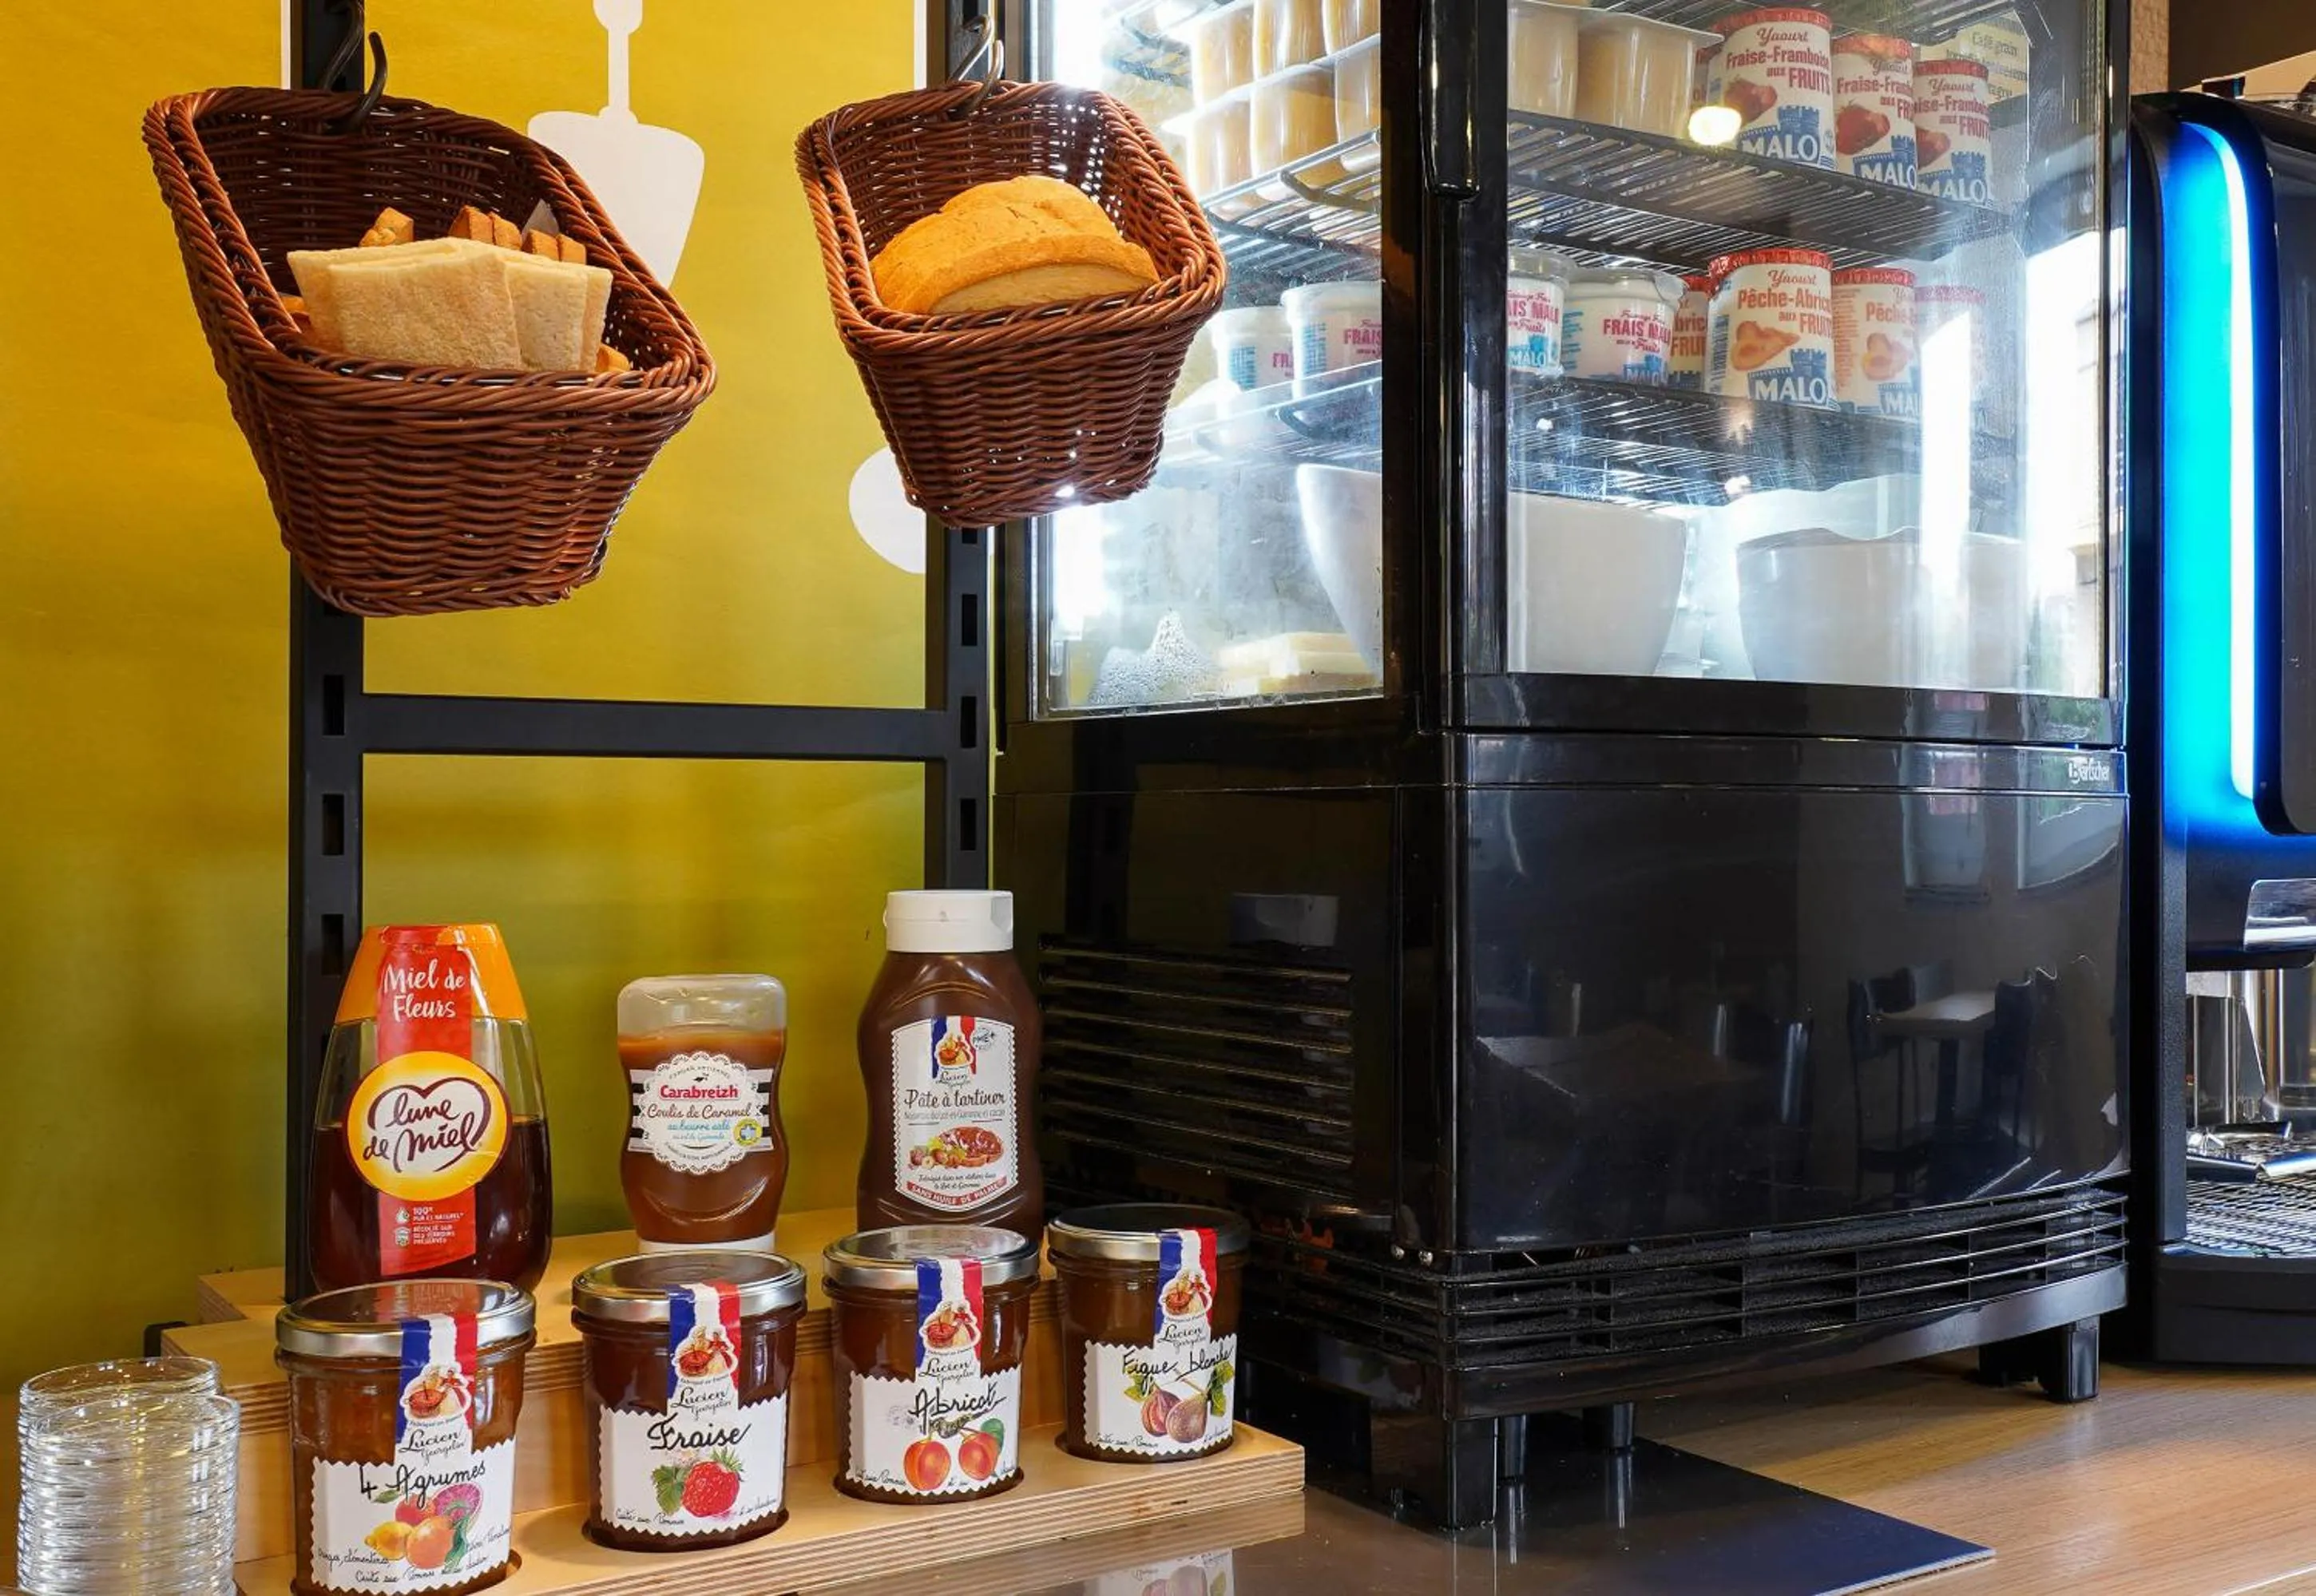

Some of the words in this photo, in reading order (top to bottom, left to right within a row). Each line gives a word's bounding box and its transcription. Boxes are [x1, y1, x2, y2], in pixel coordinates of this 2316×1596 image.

[1756, 27, 1808, 46] Yaourt
[1742, 134, 1818, 160] MALO
[1862, 163, 1916, 192] MALO
[1918, 178, 1987, 204] MALO
[1768, 270, 1817, 287] Yaourt
[1604, 319, 1644, 337] FRAIS
[1755, 376, 1826, 403] MALO
[383, 956, 439, 995] Miel
[444, 967, 466, 988] de
[391, 992, 458, 1023] Fleurs
[660, 1084, 739, 1099] Carabreizh
[904, 1089, 939, 1109] Pâte
[942, 1092, 951, 1107] à
[954, 1088, 1006, 1107] tartiner
[647, 1103, 684, 1119] Coulis
[686, 1104, 699, 1118] de
[702, 1102, 752, 1119] Caramel
[362, 1134, 390, 1162] de
[1159, 1324, 1203, 1343] Lucien
[918, 1357, 972, 1377] Lucien
[1122, 1348, 1179, 1396] Figue
[670, 1386, 729, 1408] Lucien
[908, 1381, 1007, 1436] Abricot
[399, 1428, 459, 1453] Lucien
[646, 1412, 752, 1451] Fraise
[359, 1465, 378, 1499] 4
[385, 1461, 486, 1509] Agrumes
